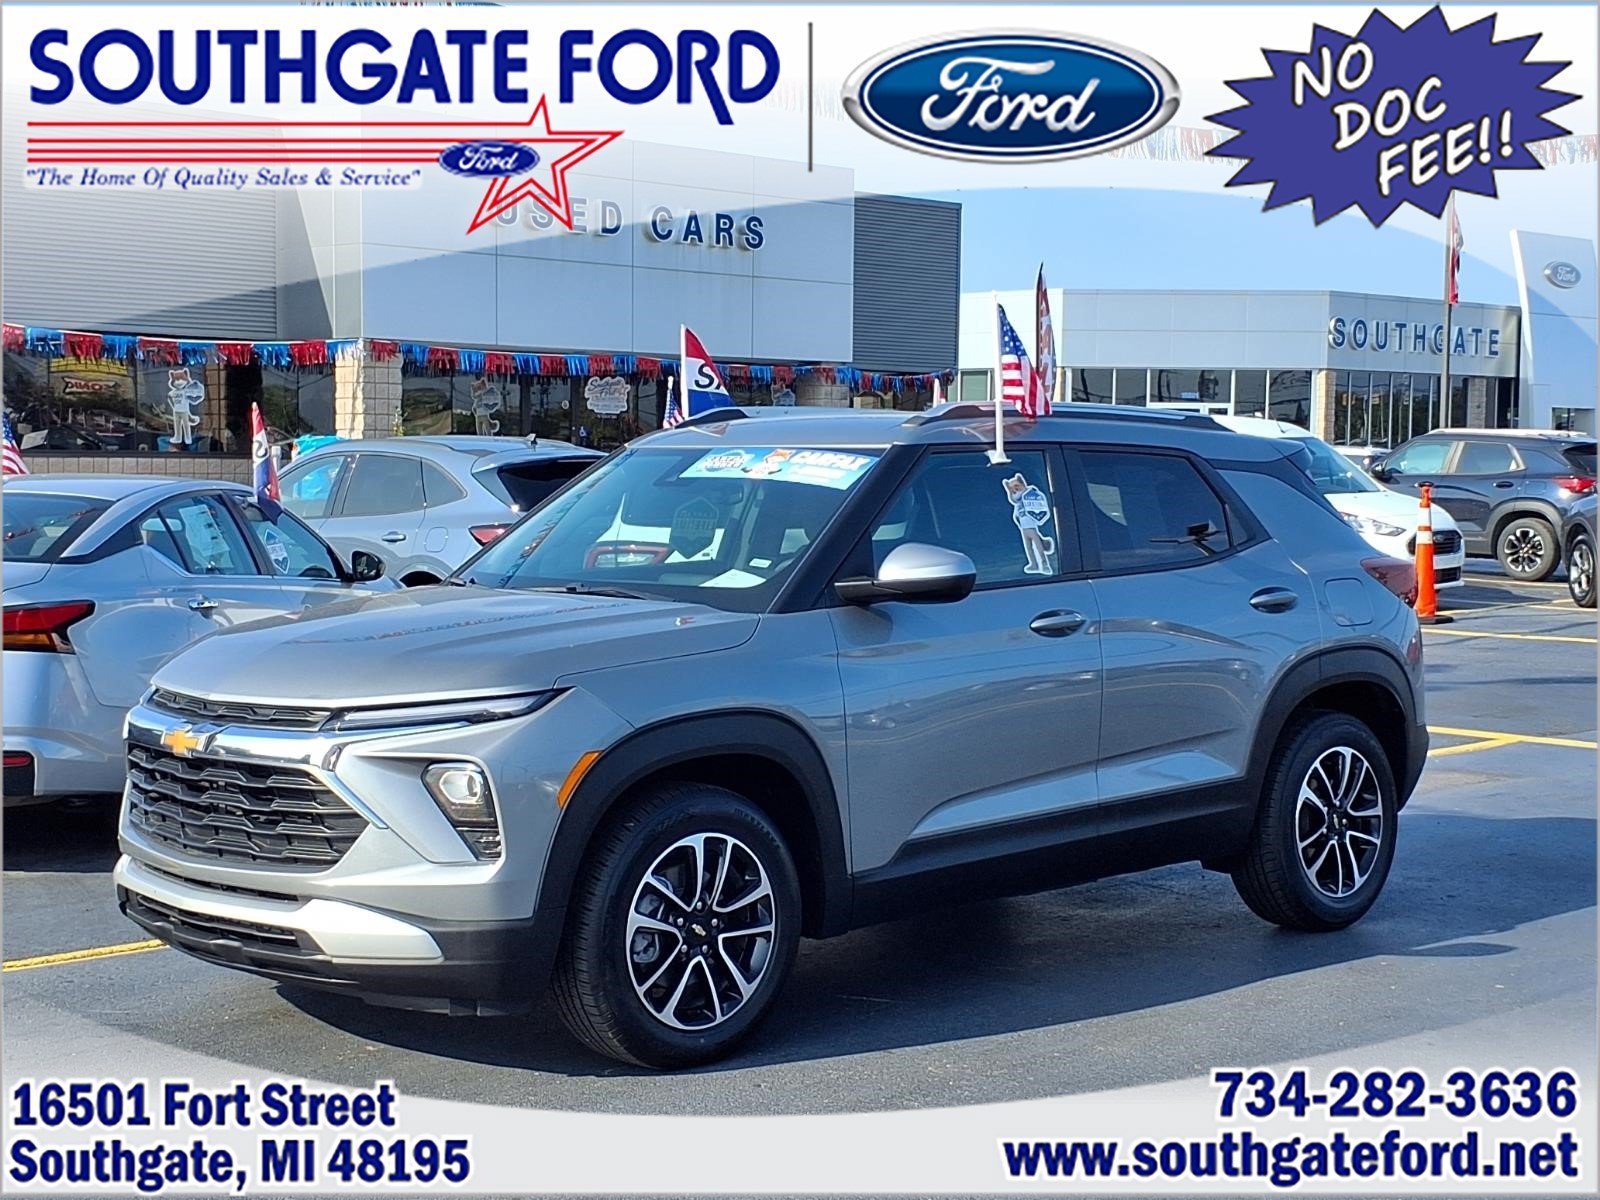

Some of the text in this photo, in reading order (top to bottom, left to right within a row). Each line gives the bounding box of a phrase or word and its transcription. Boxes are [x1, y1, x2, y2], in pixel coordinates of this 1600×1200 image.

[495, 191, 766, 250] USED CARS
[1330, 316, 1500, 357] SOUTHGATE
